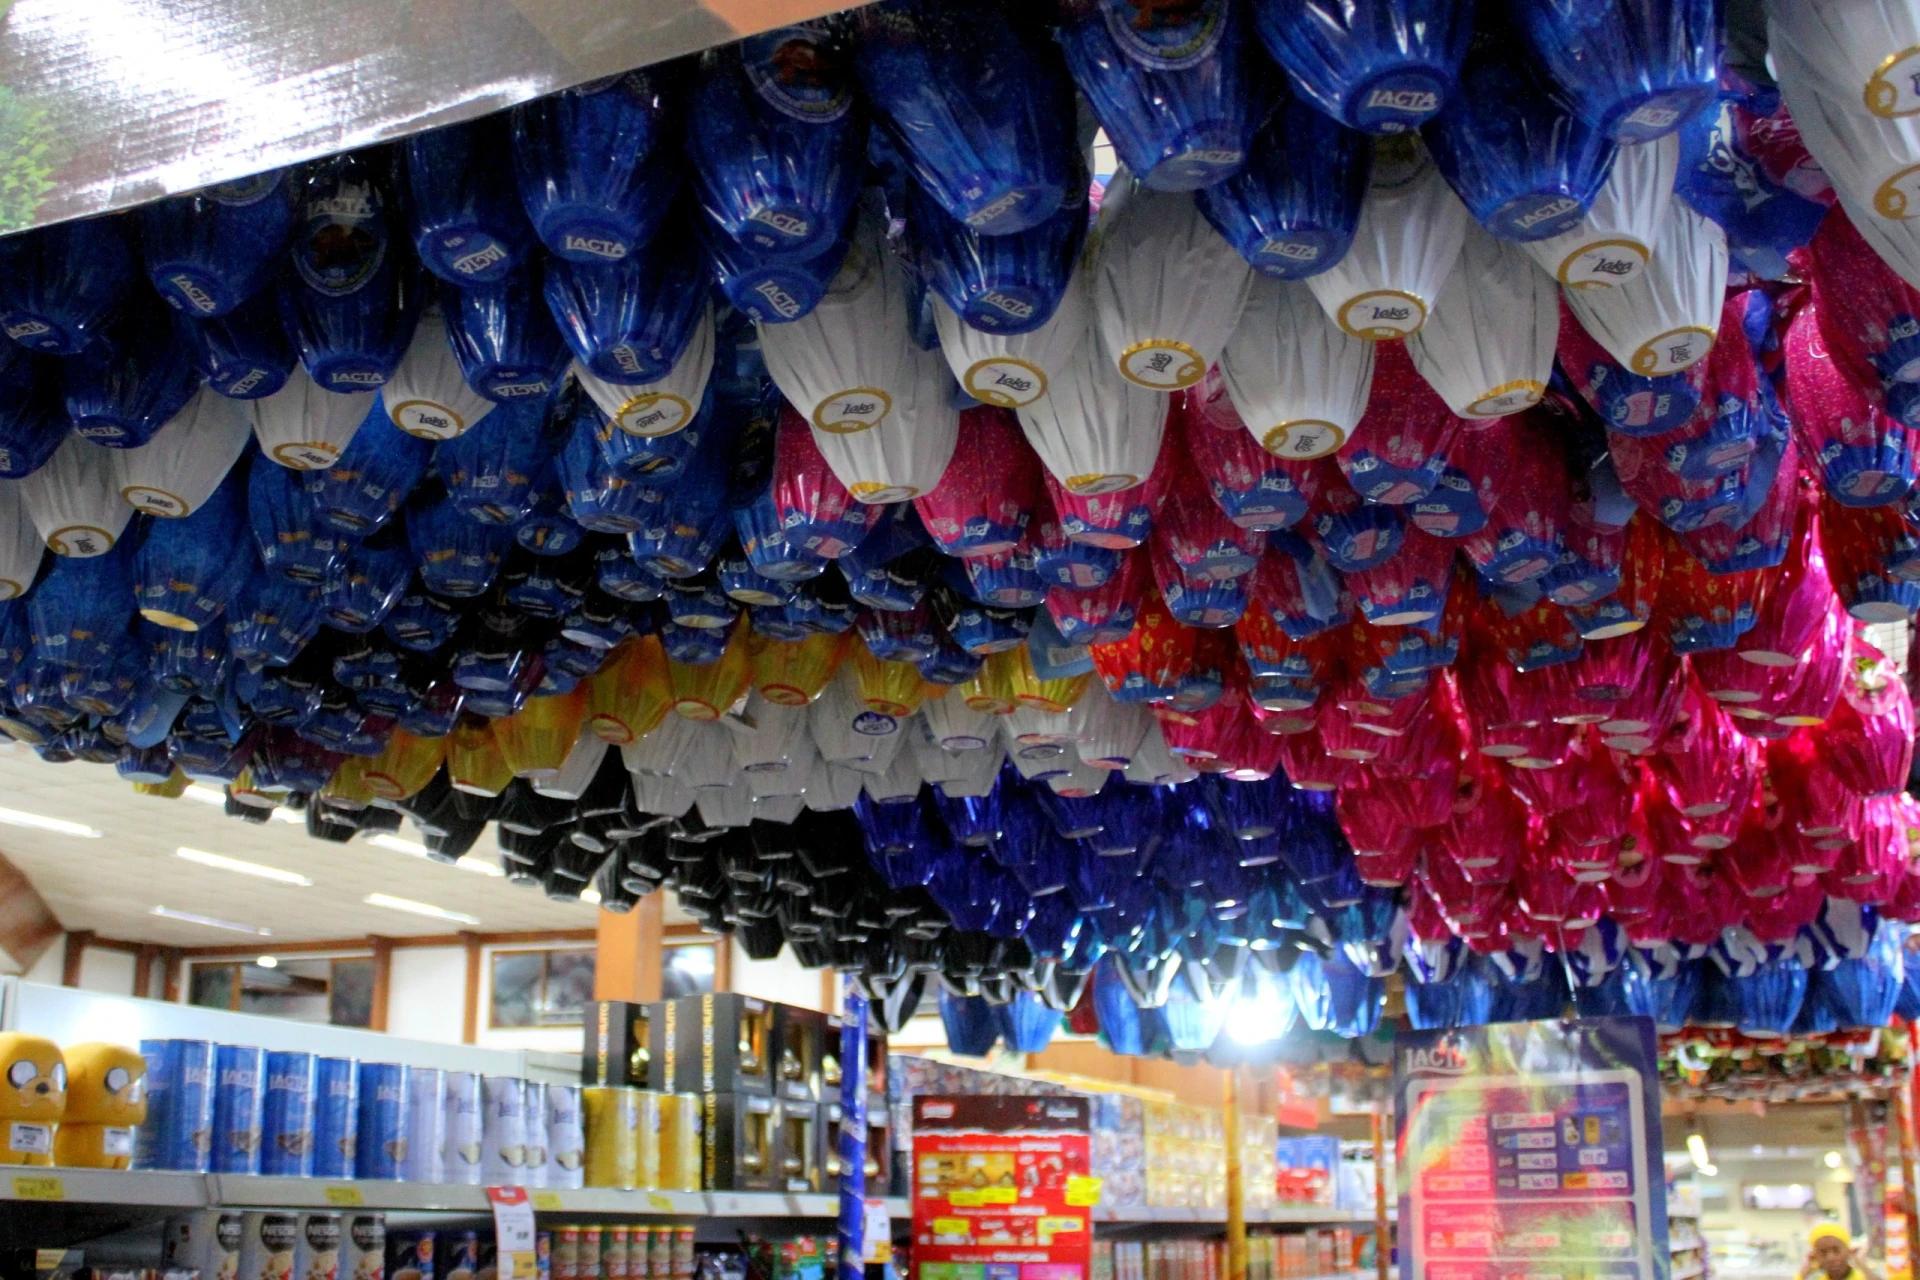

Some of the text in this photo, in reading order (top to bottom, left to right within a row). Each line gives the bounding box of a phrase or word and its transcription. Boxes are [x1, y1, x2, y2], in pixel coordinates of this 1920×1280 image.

[1367, 90, 1438, 112] LACTA
[748, 203, 808, 236] LACTA
[1513, 198, 1580, 229] LACTA
[566, 235, 626, 258] LACTA
[1260, 238, 1319, 260] LACTA
[453, 244, 507, 274] LACTA
[1592, 258, 1633, 275] Laka
[170, 274, 217, 313] LACTA
[756, 281, 800, 318] LACTA
[983, 291, 1033, 318] LACTA
[1372, 307, 1409, 320] Laka
[229, 369, 268, 394] LACTA
[332, 372, 386, 383] LACTA
[995, 373, 1031, 391] Laka
[493, 381, 549, 397] LACTA
[842, 403, 875, 415] Laka
